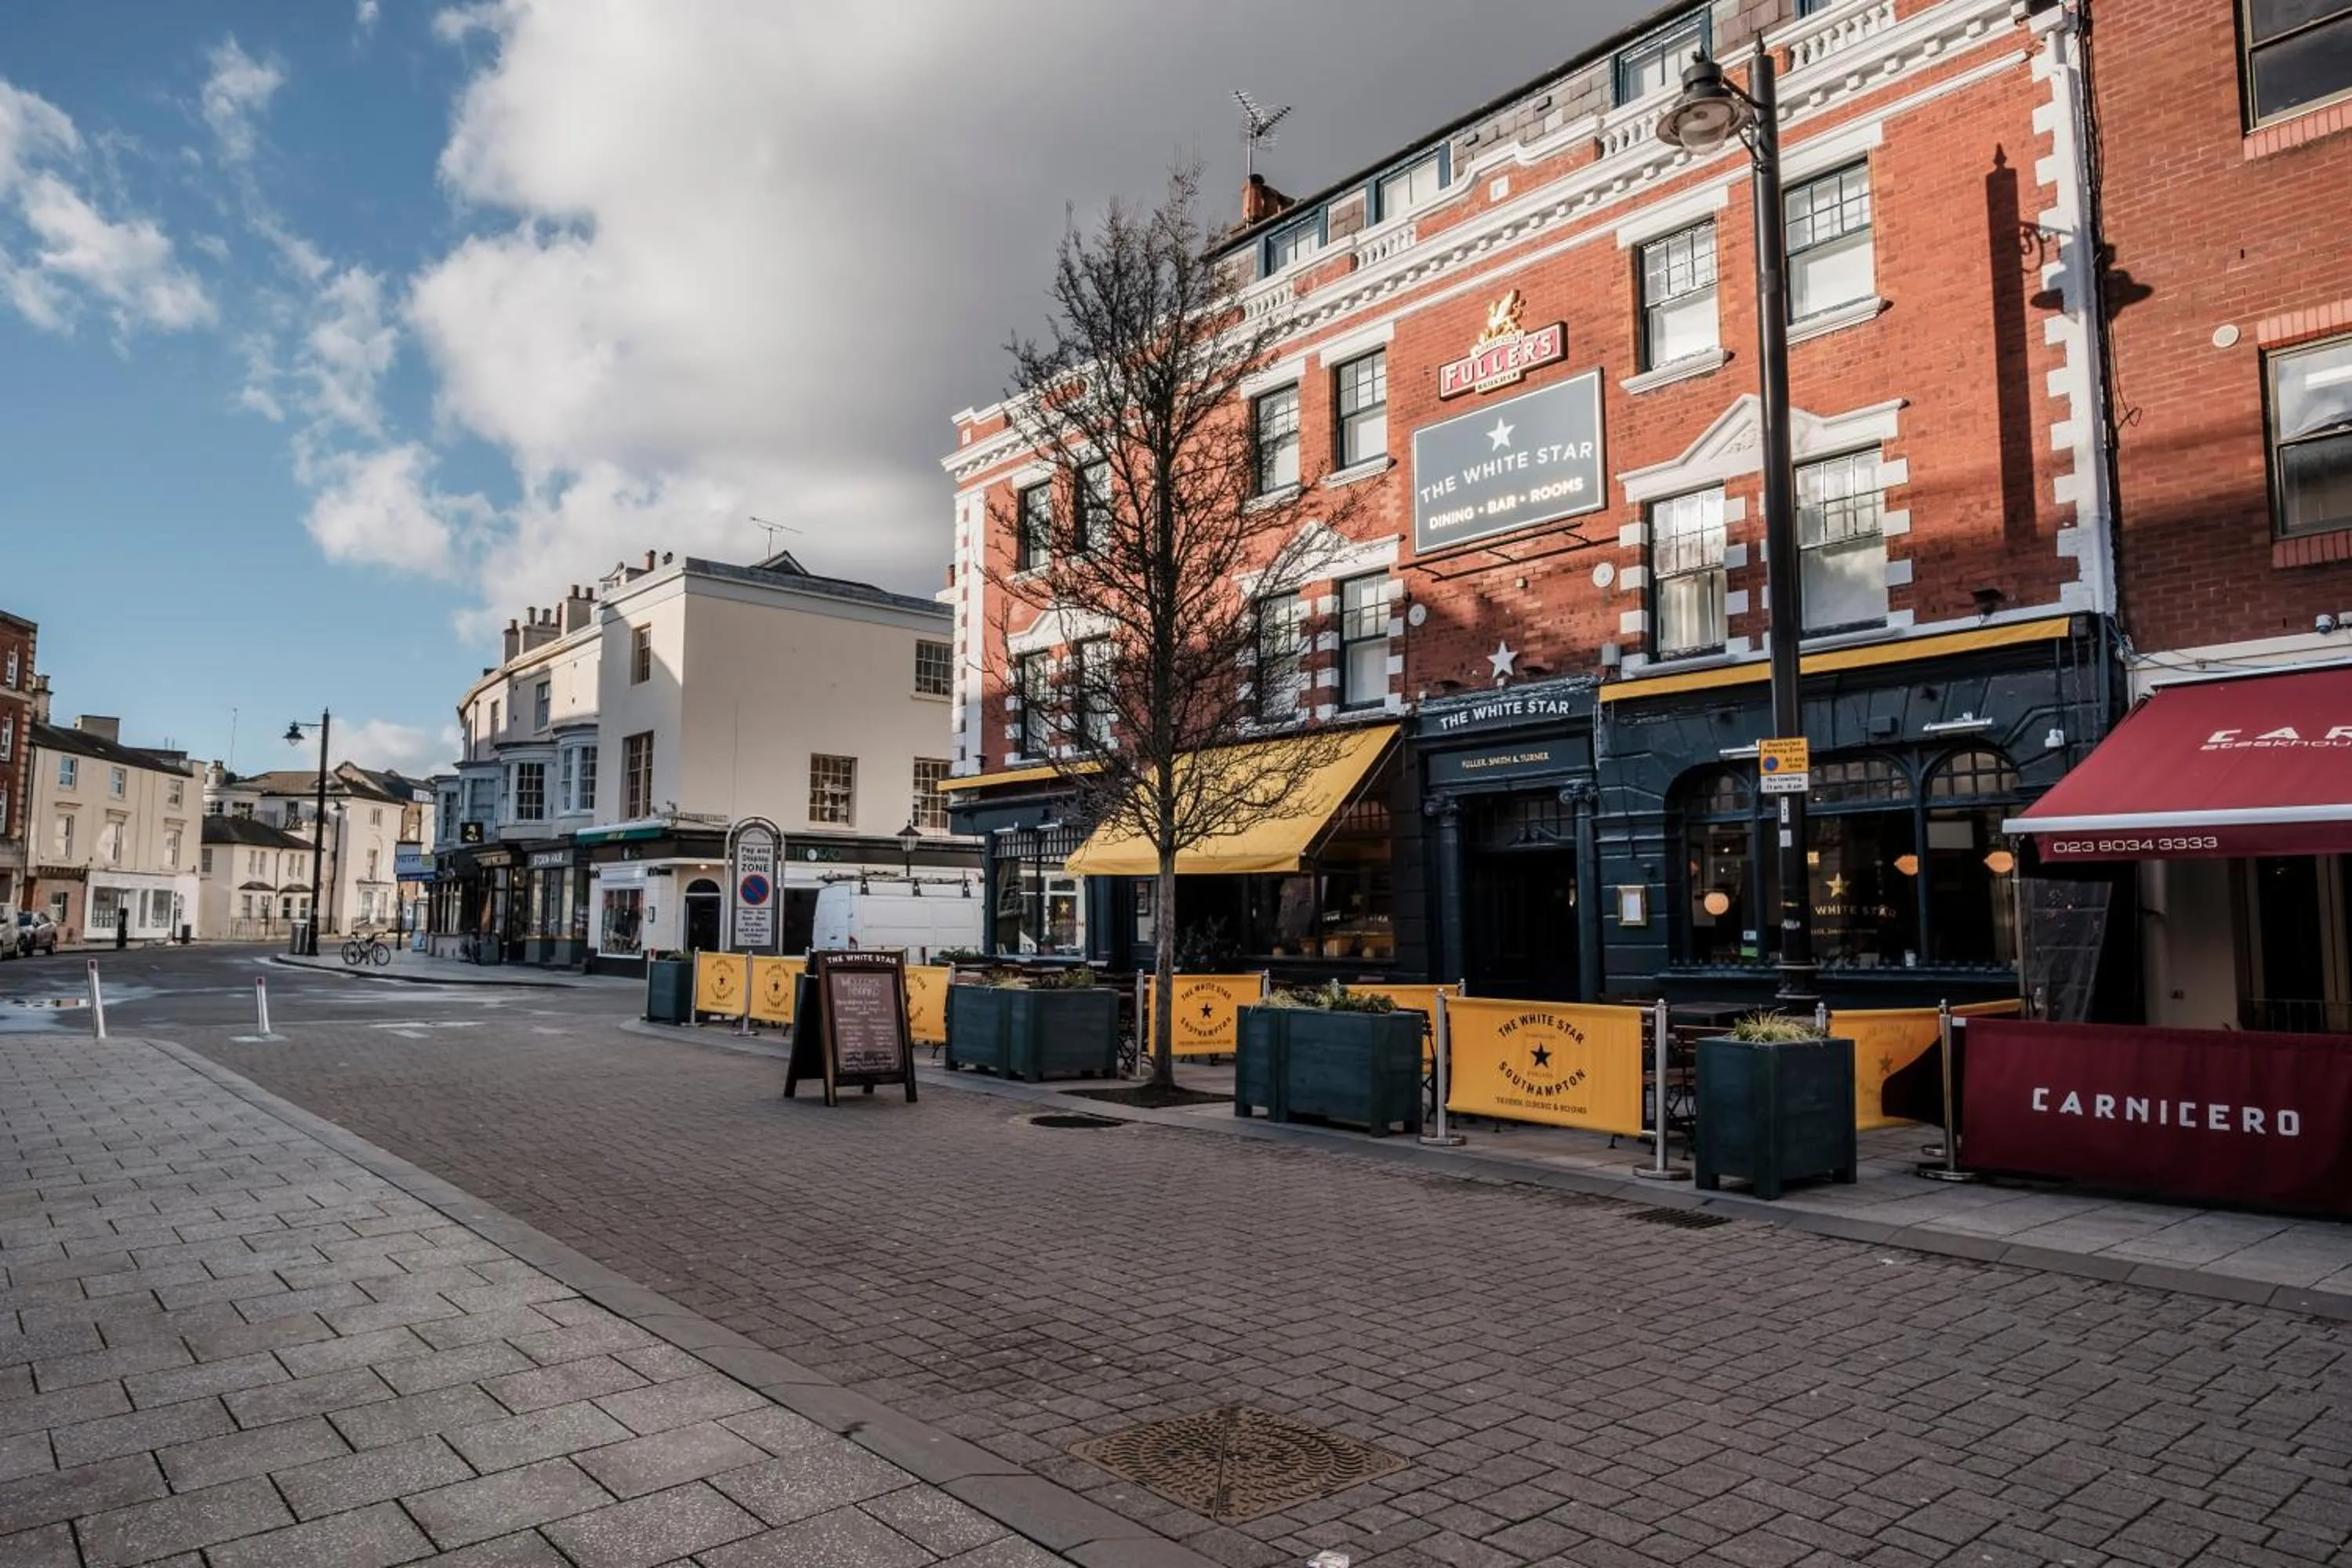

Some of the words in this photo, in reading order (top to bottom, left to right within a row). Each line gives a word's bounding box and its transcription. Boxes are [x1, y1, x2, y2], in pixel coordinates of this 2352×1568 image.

[1445, 334, 1553, 390] FULLER'S
[1420, 475, 1456, 504] THE
[1463, 451, 1529, 484] WHITE
[1537, 441, 1593, 464] STAR
[1428, 506, 1475, 530] DINING
[1487, 495, 1516, 514] BAR
[1530, 477, 1584, 503] ROOMS
[1439, 711, 1468, 730] THE
[1473, 702, 1523, 720] WHITE
[1528, 700, 1569, 714] STAR
[741, 847, 754, 855] Pay
[2053, 840, 2094, 853] 023
[2099, 840, 2154, 852] 8034
[2158, 837, 2218, 851] 3333
[741, 864, 769, 873] ZONE
[1815, 905, 1857, 916] WHITE
[826, 956, 843, 964] THE
[876, 955, 897, 964] STAR
[1498, 1018, 1519, 1037] THE
[1519, 1013, 1554, 1026] WHITE
[1556, 1019, 1584, 1044] STAR
[1498, 1062, 1586, 1097] SOUTHAMPTON
[2032, 1087, 2299, 1137] CARNICERO
